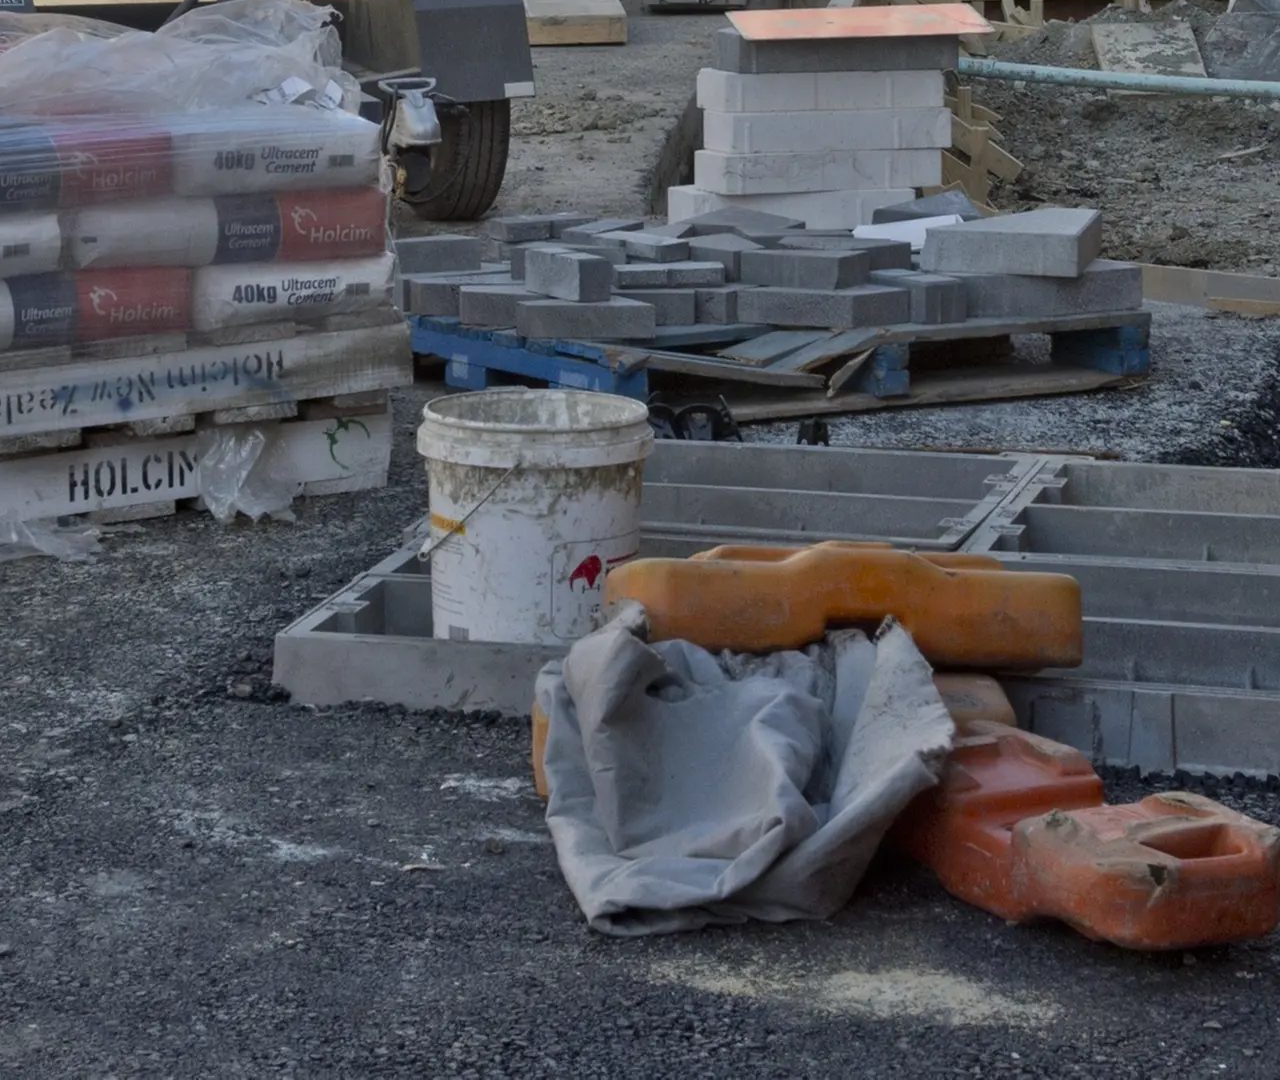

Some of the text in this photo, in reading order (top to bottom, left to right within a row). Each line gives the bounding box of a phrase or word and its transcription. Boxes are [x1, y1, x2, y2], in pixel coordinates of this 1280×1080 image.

[260, 146, 319, 161] Ultracem
[265, 160, 317, 174] Cement
[225, 221, 274, 236] Ultracem
[309, 224, 370, 244] Holcim
[232, 277, 337, 305] 40kg Ultracem
[287, 291, 335, 306] Cement
[110, 303, 174, 322] Holcim
